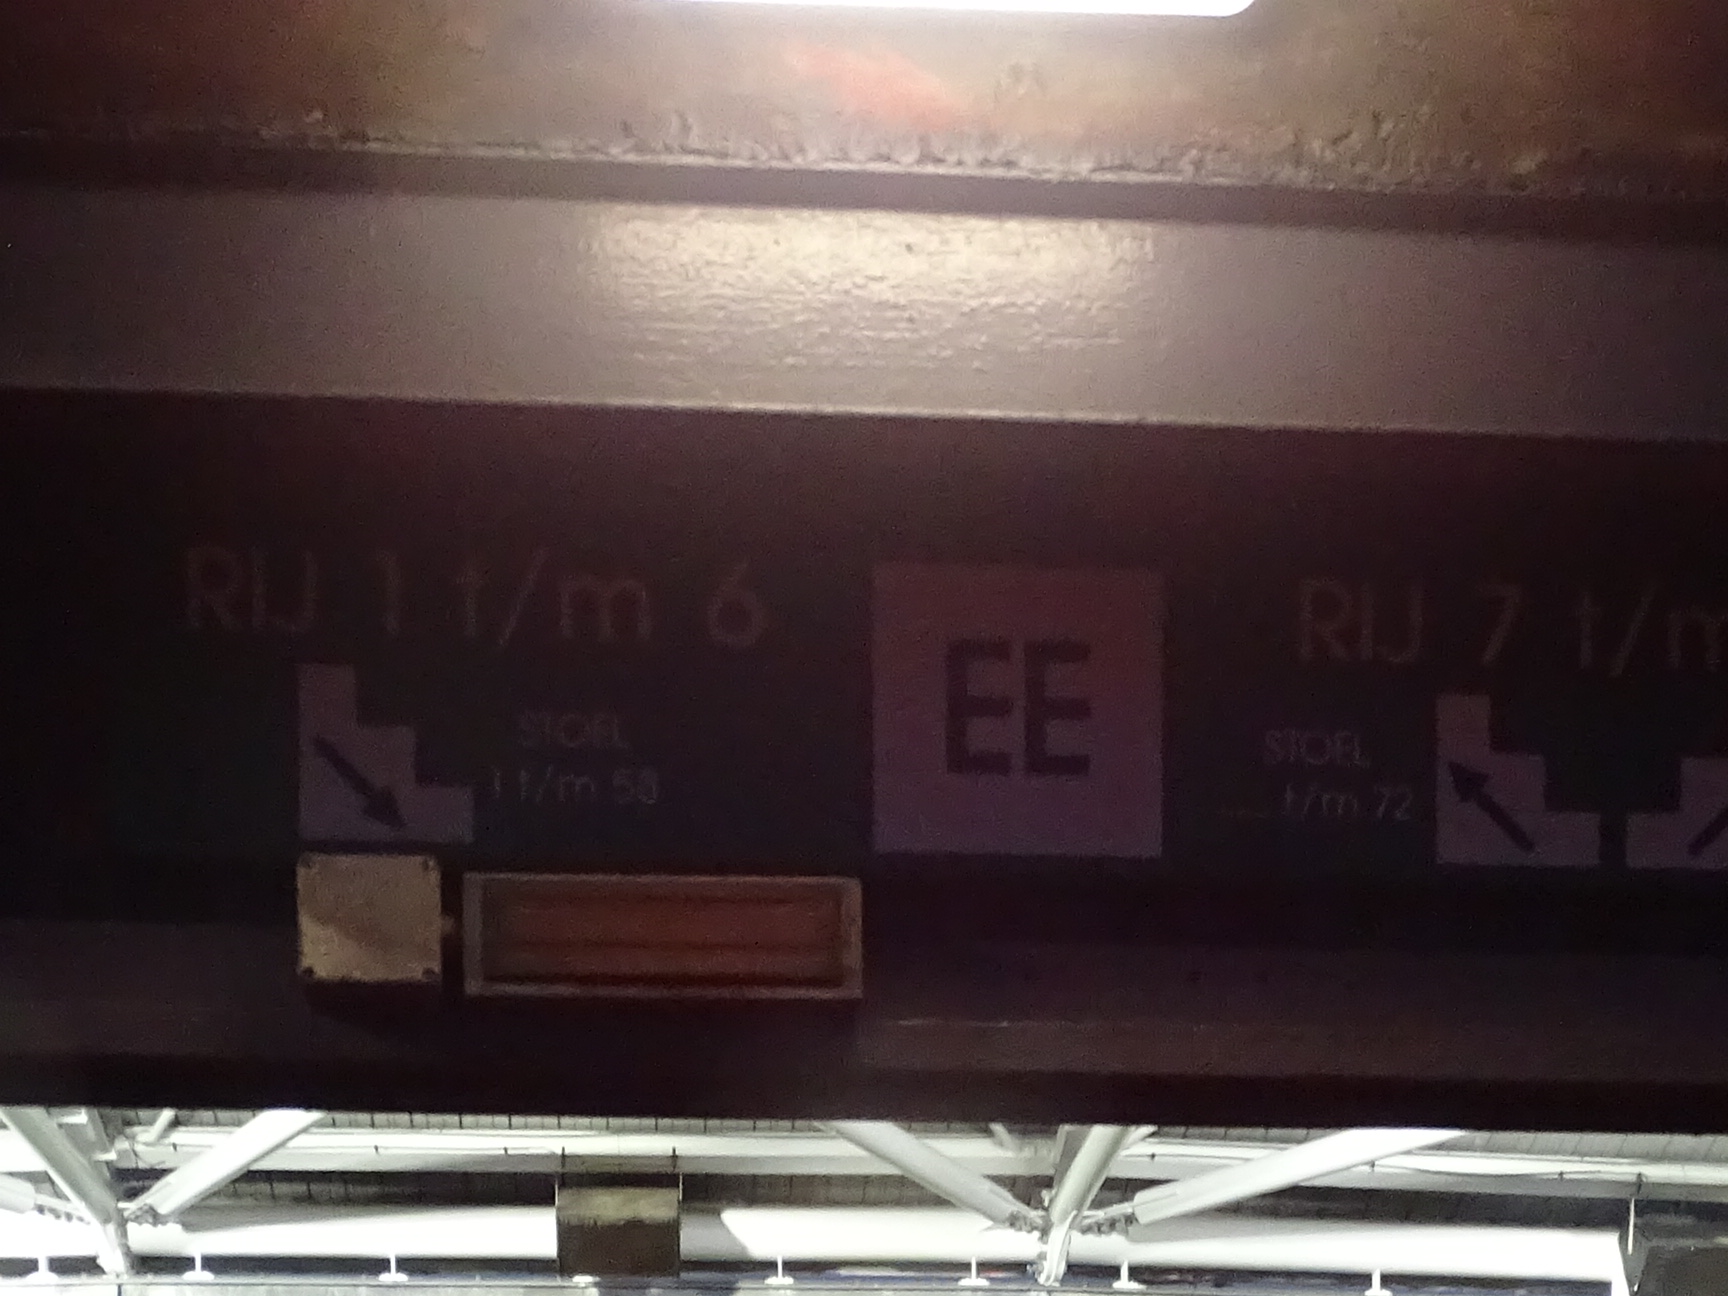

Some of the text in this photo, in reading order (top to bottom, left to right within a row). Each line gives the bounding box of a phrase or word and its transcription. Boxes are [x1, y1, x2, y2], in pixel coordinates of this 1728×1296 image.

[186, 546, 319, 634] RIJ
[707, 558, 767, 648] 6
[1299, 577, 1424, 665] RIJ
[1479, 582, 1524, 667] 7
[947, 640, 1092, 776] EE
